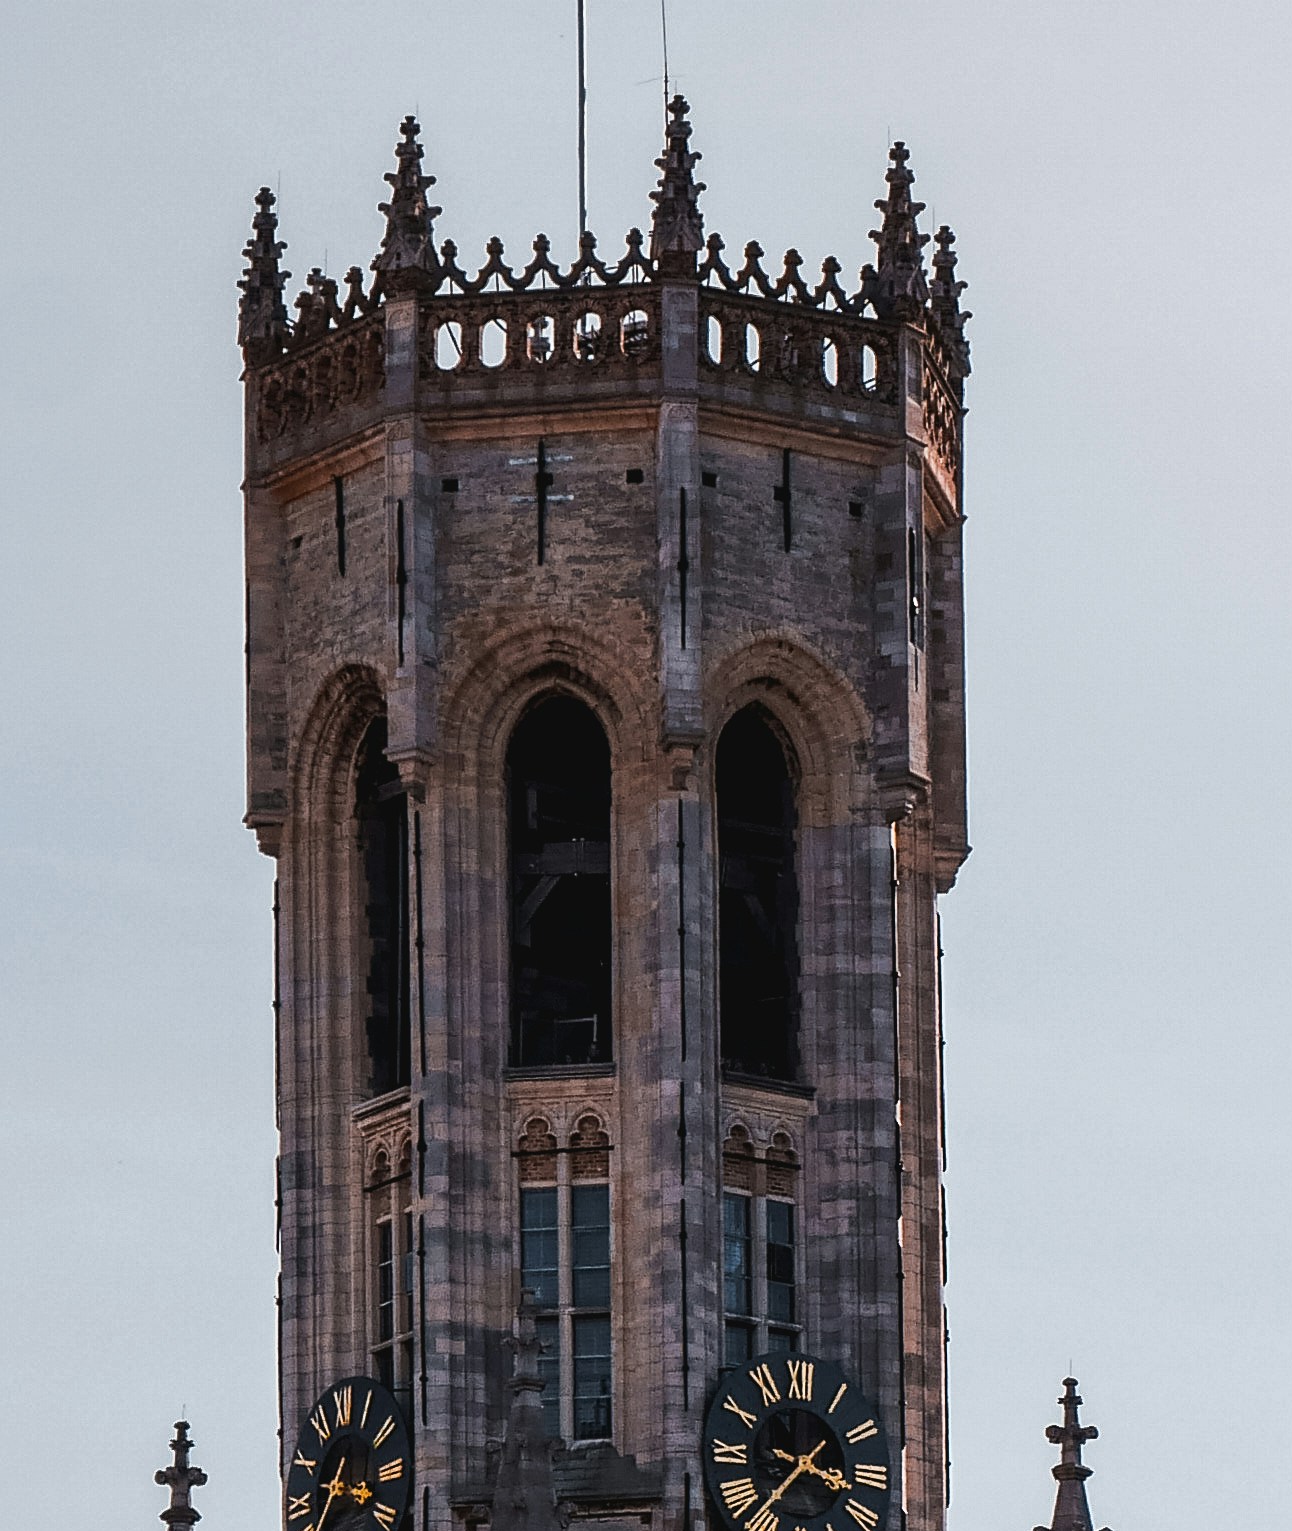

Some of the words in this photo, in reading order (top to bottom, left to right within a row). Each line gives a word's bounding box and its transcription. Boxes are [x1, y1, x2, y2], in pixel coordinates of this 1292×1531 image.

[749, 1363, 781, 1407] XI
[787, 1360, 815, 1402] XII
[722, 1395, 757, 1429] X
[845, 1418, 878, 1444] II
[377, 1457, 403, 1482] III
[854, 1463, 887, 1490] III
